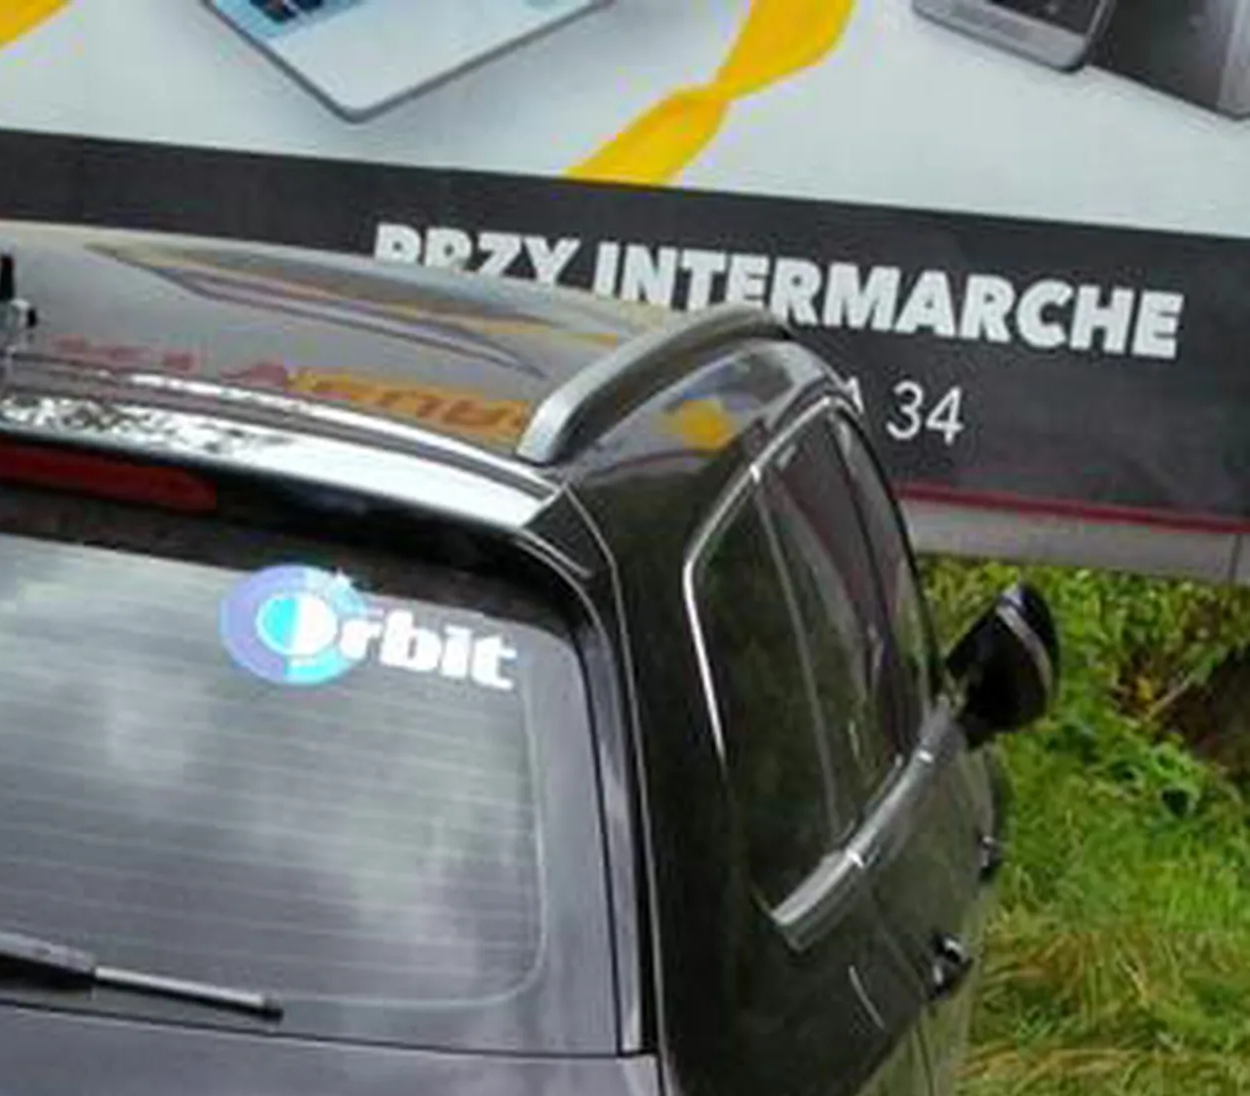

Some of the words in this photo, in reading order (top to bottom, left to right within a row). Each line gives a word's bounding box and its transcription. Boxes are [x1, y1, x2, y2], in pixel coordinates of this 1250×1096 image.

[595, 241, 1183, 358] INTERMARCHE
[886, 380, 964, 445] 34
[219, 563, 517, 690] Orbit
